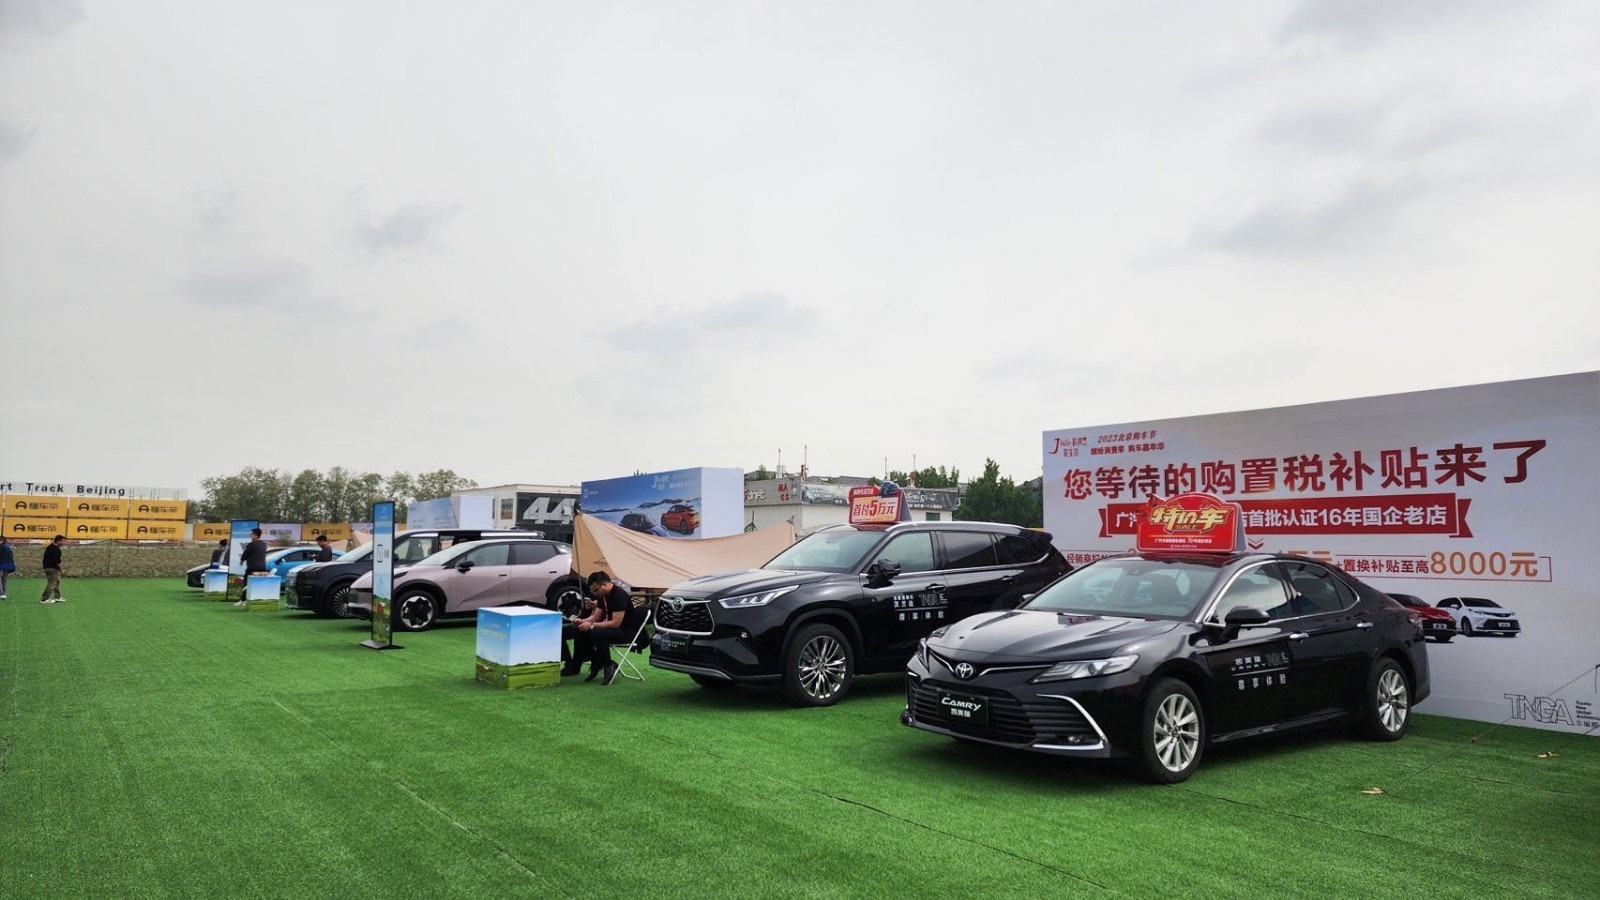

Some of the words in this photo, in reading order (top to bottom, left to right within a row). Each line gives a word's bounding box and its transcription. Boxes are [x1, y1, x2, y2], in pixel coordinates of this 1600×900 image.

[1128, 442, 1165, 453] 购车嘉年华
[1064, 440, 1547, 500] 您等待的购置税补贴来了
[26, 482, 64, 493] Track
[77, 485, 125, 496] Beijing
[853, 499, 896, 516] 首付5万元
[1151, 506, 1229, 532] 特价车
[941, 697, 982, 711] CAMRY
[1503, 693, 1575, 727] TNGA
